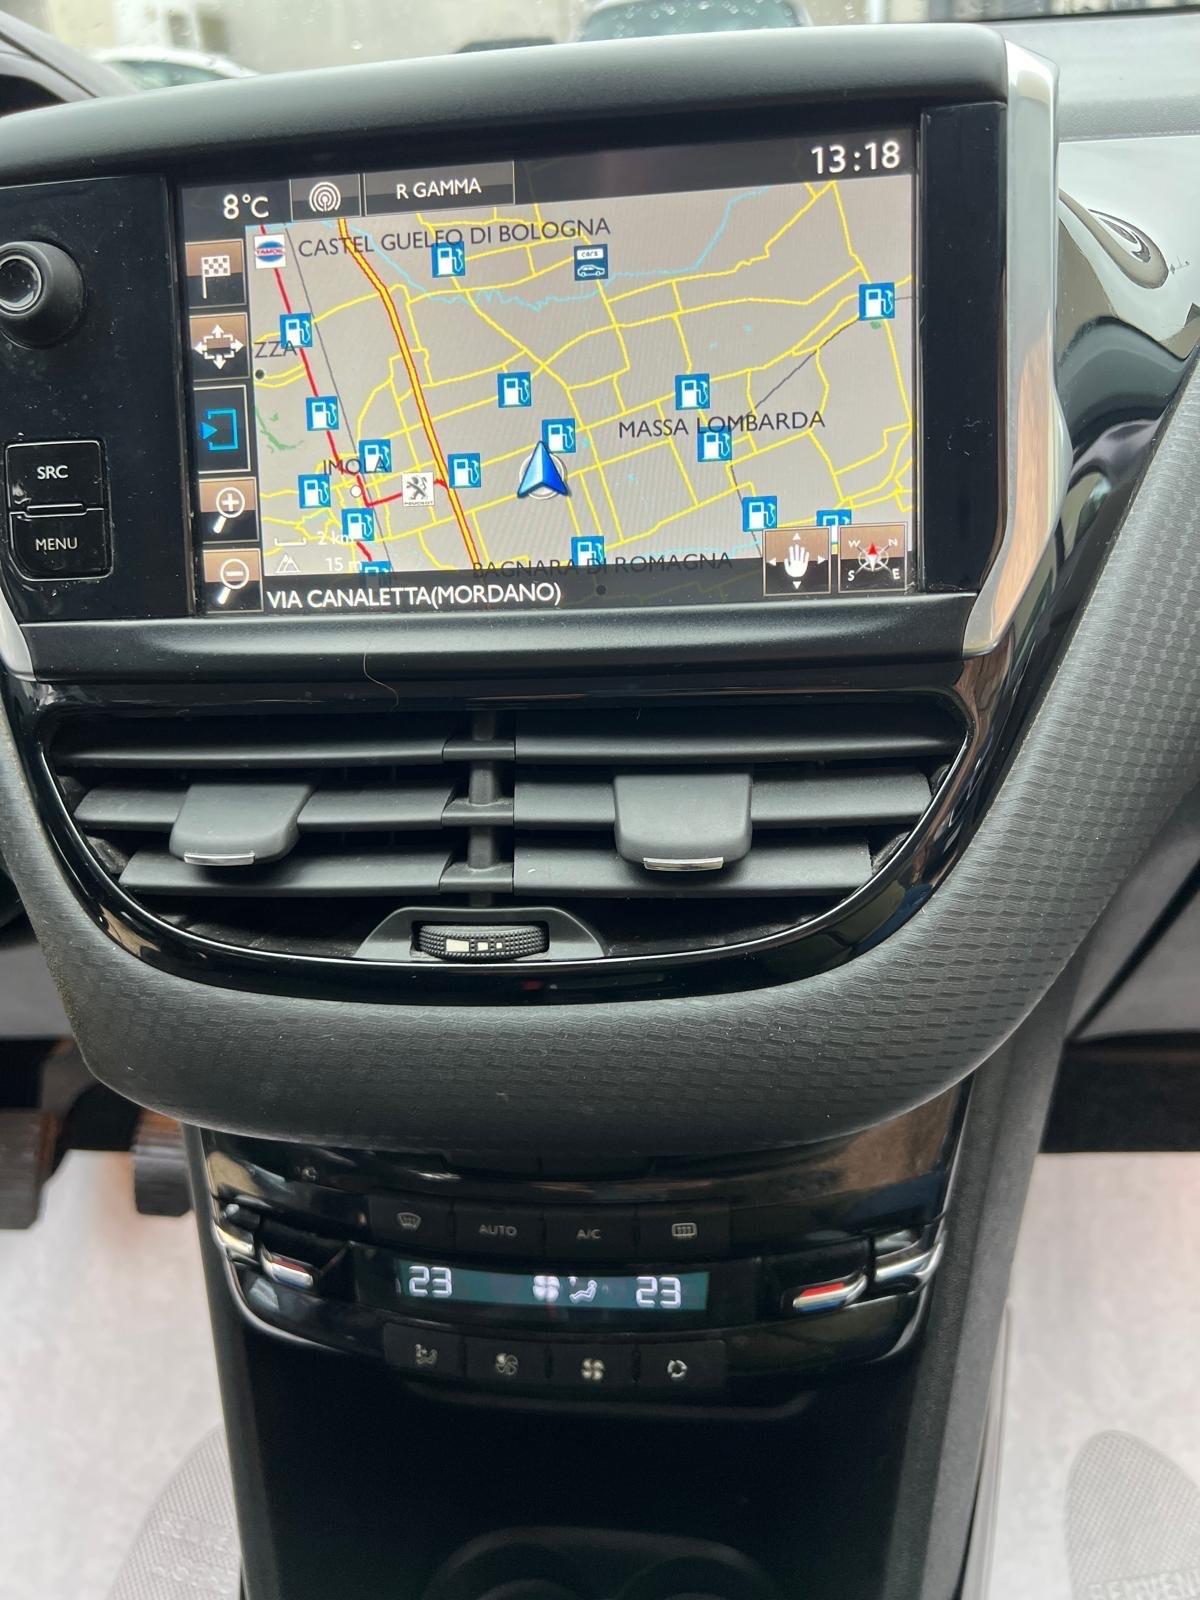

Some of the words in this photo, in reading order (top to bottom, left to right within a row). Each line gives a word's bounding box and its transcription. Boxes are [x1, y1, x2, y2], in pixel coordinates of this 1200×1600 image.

[810, 140, 901, 175] 13:18
[396, 183, 409, 200] R
[413, 177, 482, 198] GAMMA
[222, 193, 270, 220] 8°C
[298, 234, 374, 258] CASTEL
[381, 227, 463, 251] GUELFO
[470, 226, 492, 245] DI
[499, 217, 611, 243] BOLOGNA
[618, 416, 689, 439] MASSA
[696, 410, 826, 434] LOMBARDA
[36, 465, 69, 480] SRC
[323, 456, 389, 475] IMOLA
[35, 537, 78, 551] MENU
[317, 531, 328, 546] 2
[848, 539, 861, 548] W
[888, 538, 898, 547] N
[325, 556, 344, 572] 15
[473, 559, 579, 578] BAGNARA
[587, 555, 607, 574] DI
[615, 552, 733, 573] ROMAGNA
[847, 569, 855, 582] S
[892, 568, 901, 580] E
[266, 590, 303, 609] VIA
[307, 582, 562, 608] CANALETTA(MORDANO)
[479, 1224, 518, 1237] AUTO
[576, 1228, 601, 1240] A/C
[409, 1265, 452, 1298] 23
[636, 1276, 682, 1309] 23
